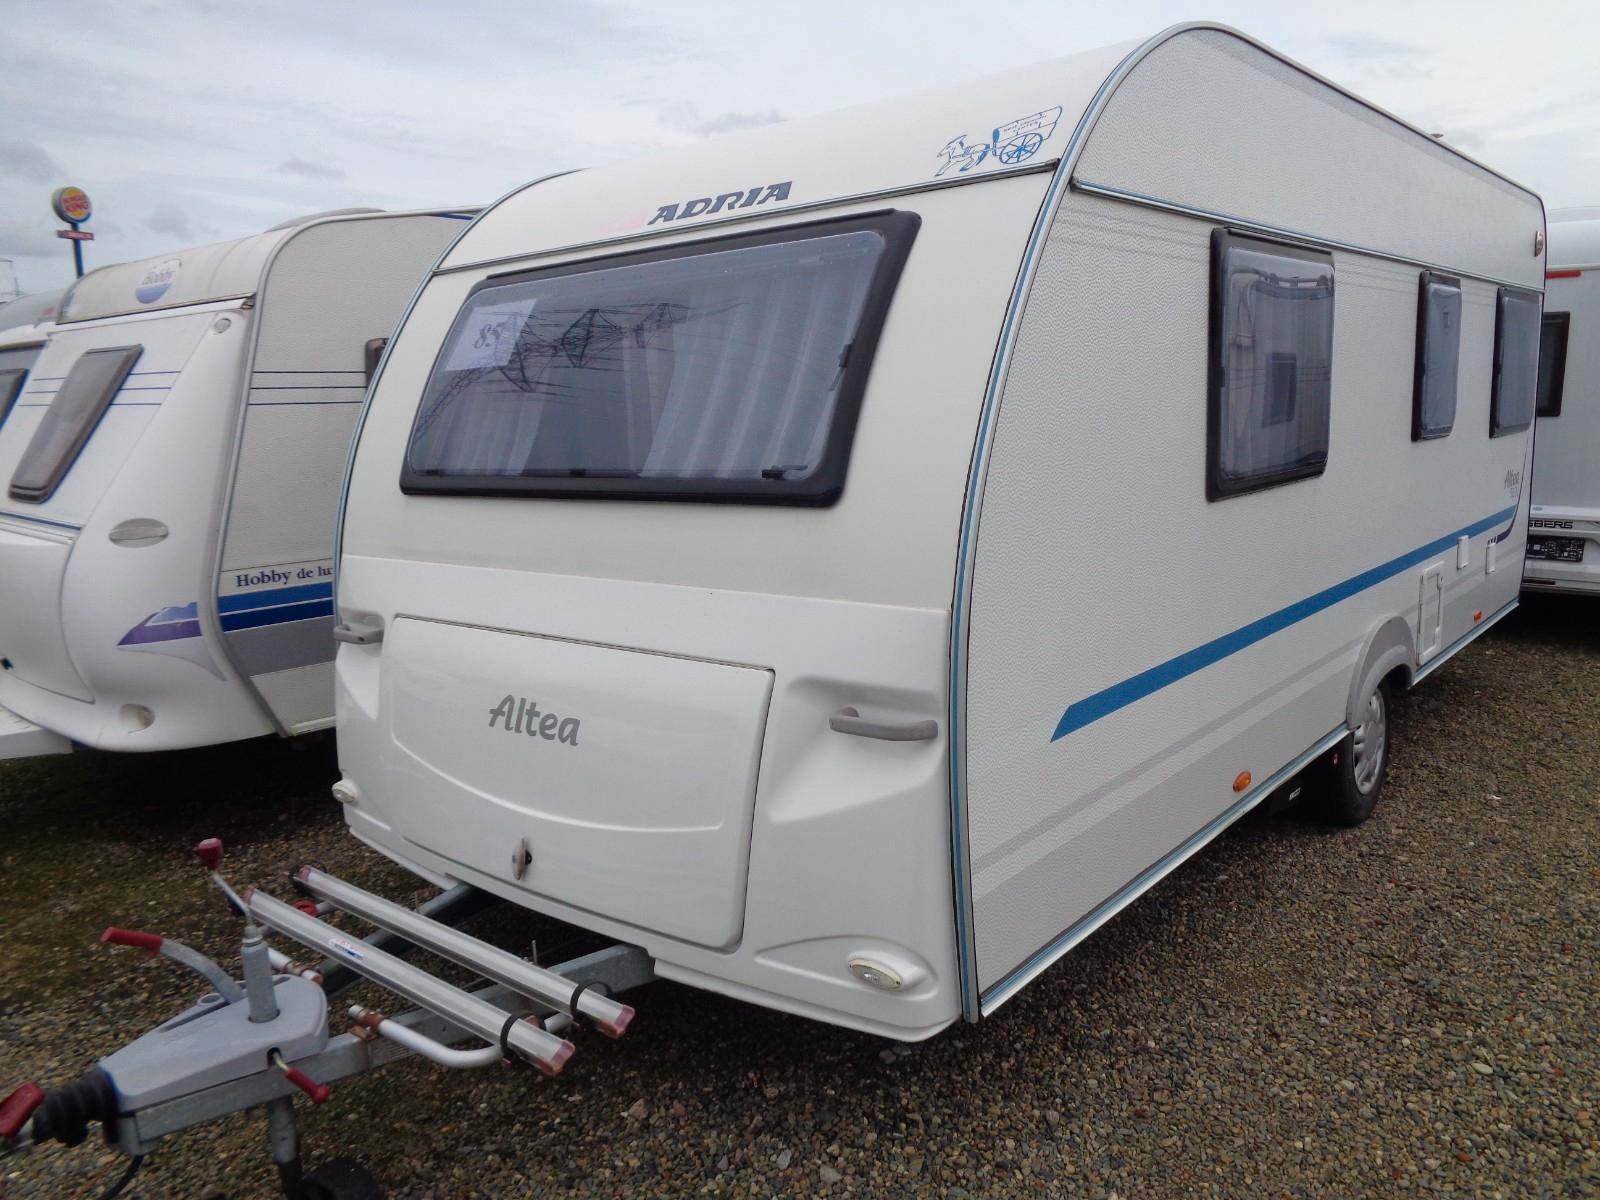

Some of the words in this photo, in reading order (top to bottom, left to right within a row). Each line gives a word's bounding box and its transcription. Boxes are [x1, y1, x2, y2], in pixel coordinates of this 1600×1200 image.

[646, 181, 793, 226] ADRIA
[235, 570, 292, 588] Hobby
[296, 567, 314, 580] de
[488, 694, 581, 747] Altea
